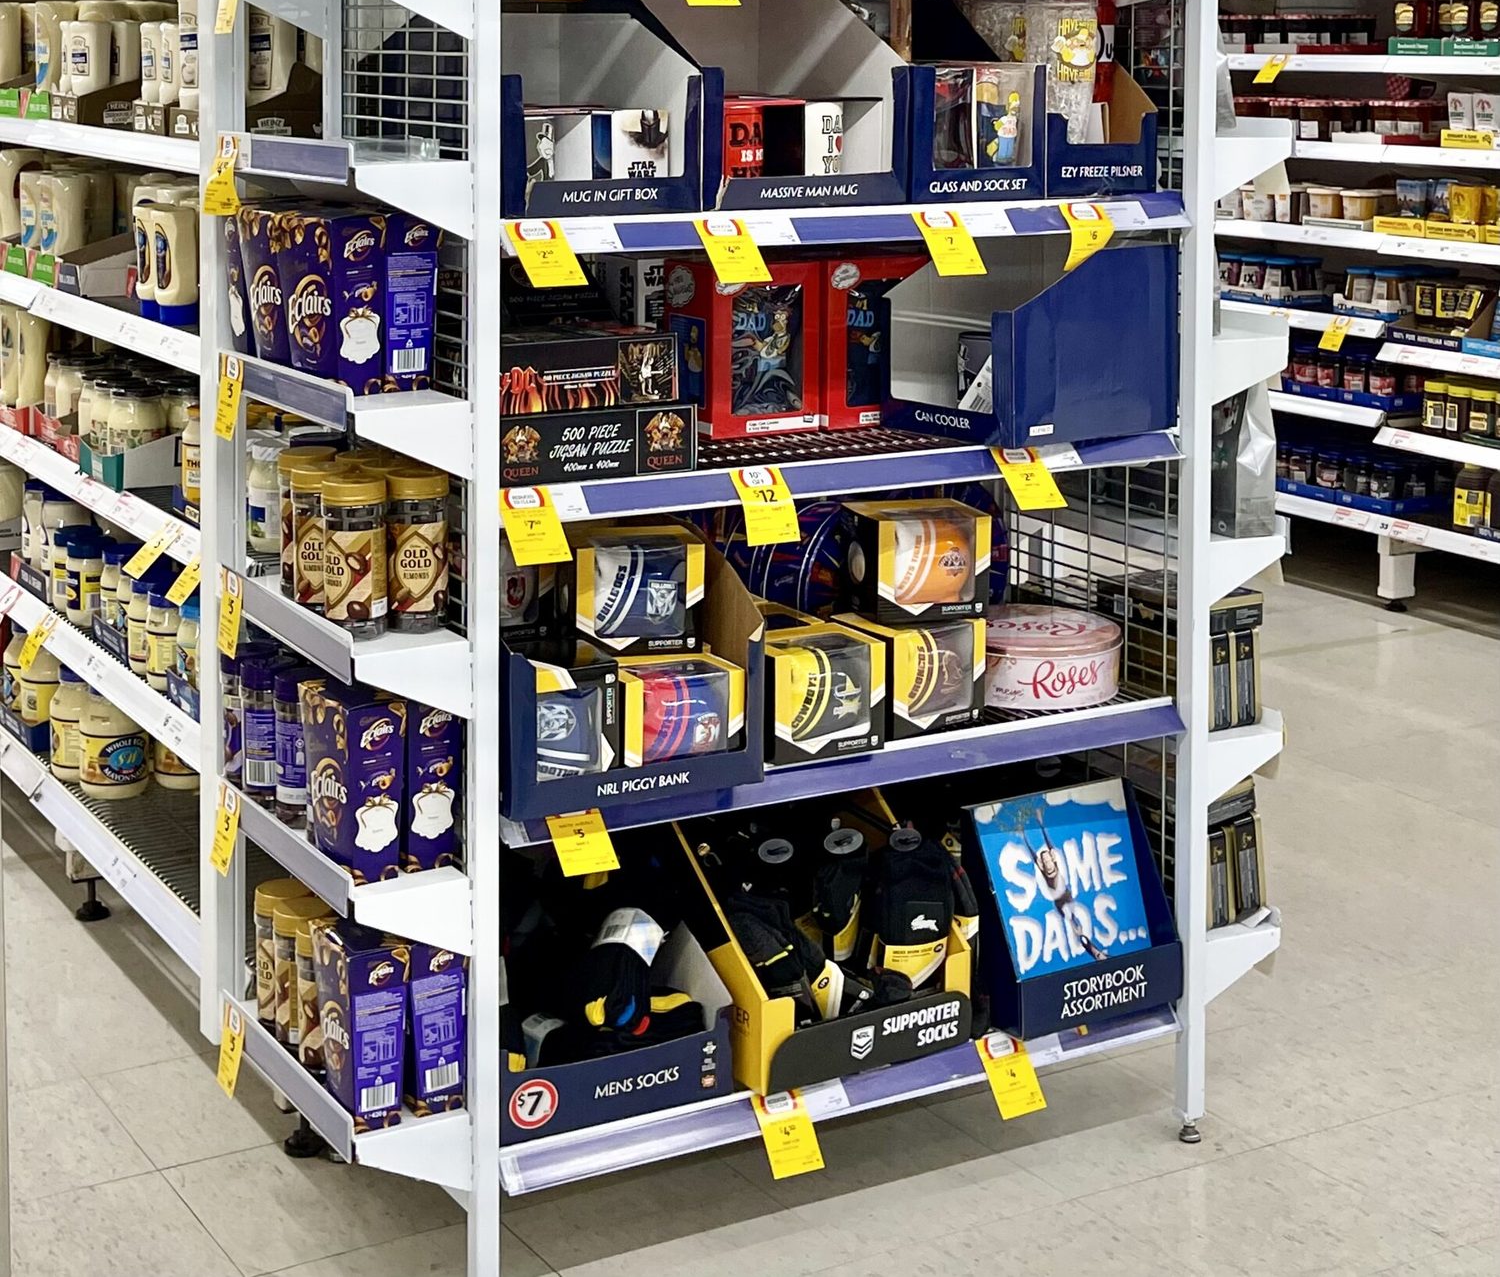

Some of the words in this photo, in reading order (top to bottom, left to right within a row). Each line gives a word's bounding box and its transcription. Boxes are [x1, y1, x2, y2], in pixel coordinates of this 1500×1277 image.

[628, 161, 656, 171] STAR
[1061, 167, 1077, 179] EZY
[1079, 166, 1110, 178] FREEZE
[1111, 165, 1143, 178] PILSNER
[562, 189, 591, 203] MUG
[594, 189, 606, 202] IN
[609, 188, 632, 202] GIFT
[634, 188, 658, 201] BOX
[760, 186, 803, 199] MASSIVE
[805, 185, 831, 197] MAN
[832, 184, 858, 196] MUG
[929, 181, 958, 193] GLASS
[960, 180, 982, 192] AND
[984, 179, 1010, 191] SOCK
[1011, 178, 1027, 190] SET
[344, 236, 375, 260] Eclairs
[250, 281, 282, 316] Eclairs
[288, 295, 331, 335] Eclairs
[735, 312, 766, 331] DAD
[847, 310, 874, 327] DAD
[915, 409, 933, 423] CAN
[935, 413, 970, 429] COOLER
[562, 426, 584, 441] 500
[588, 423, 621, 439] PIECE
[550, 443, 591, 461] JIGSAW
[591, 439, 634, 456] PUZZLE
[503, 466, 539, 479] QUEEN
[647, 455, 683, 470] QUEEN
[753, 489, 778, 503] $12
[301, 551, 323, 561] GOL
[304, 542, 323, 551] OLD
[404, 549, 427, 559] OLD
[400, 559, 431, 569] GOLD
[942, 604, 972, 612] SUPPORTER
[1017, 659, 1105, 699] Roses
[606, 687, 614, 725] SUPPORTER
[360, 722, 394, 749] Eclairs
[310, 771, 348, 808] Eclairs
[597, 783, 619, 797] NRL
[621, 777, 657, 793] PIGGY
[658, 771, 690, 789] BANK
[999, 830, 1128, 914] SOME
[1063, 964, 1145, 998] STORYBOOK
[1060, 982, 1147, 1020] ASSORTMENT
[882, 1000, 960, 1036] SUPPORTER
[917, 1020, 959, 1047] SOCKS
[594, 1078, 634, 1100] MENS
[636, 1066, 680, 1089] SOCKS
[517, 1089, 544, 1116] $7
